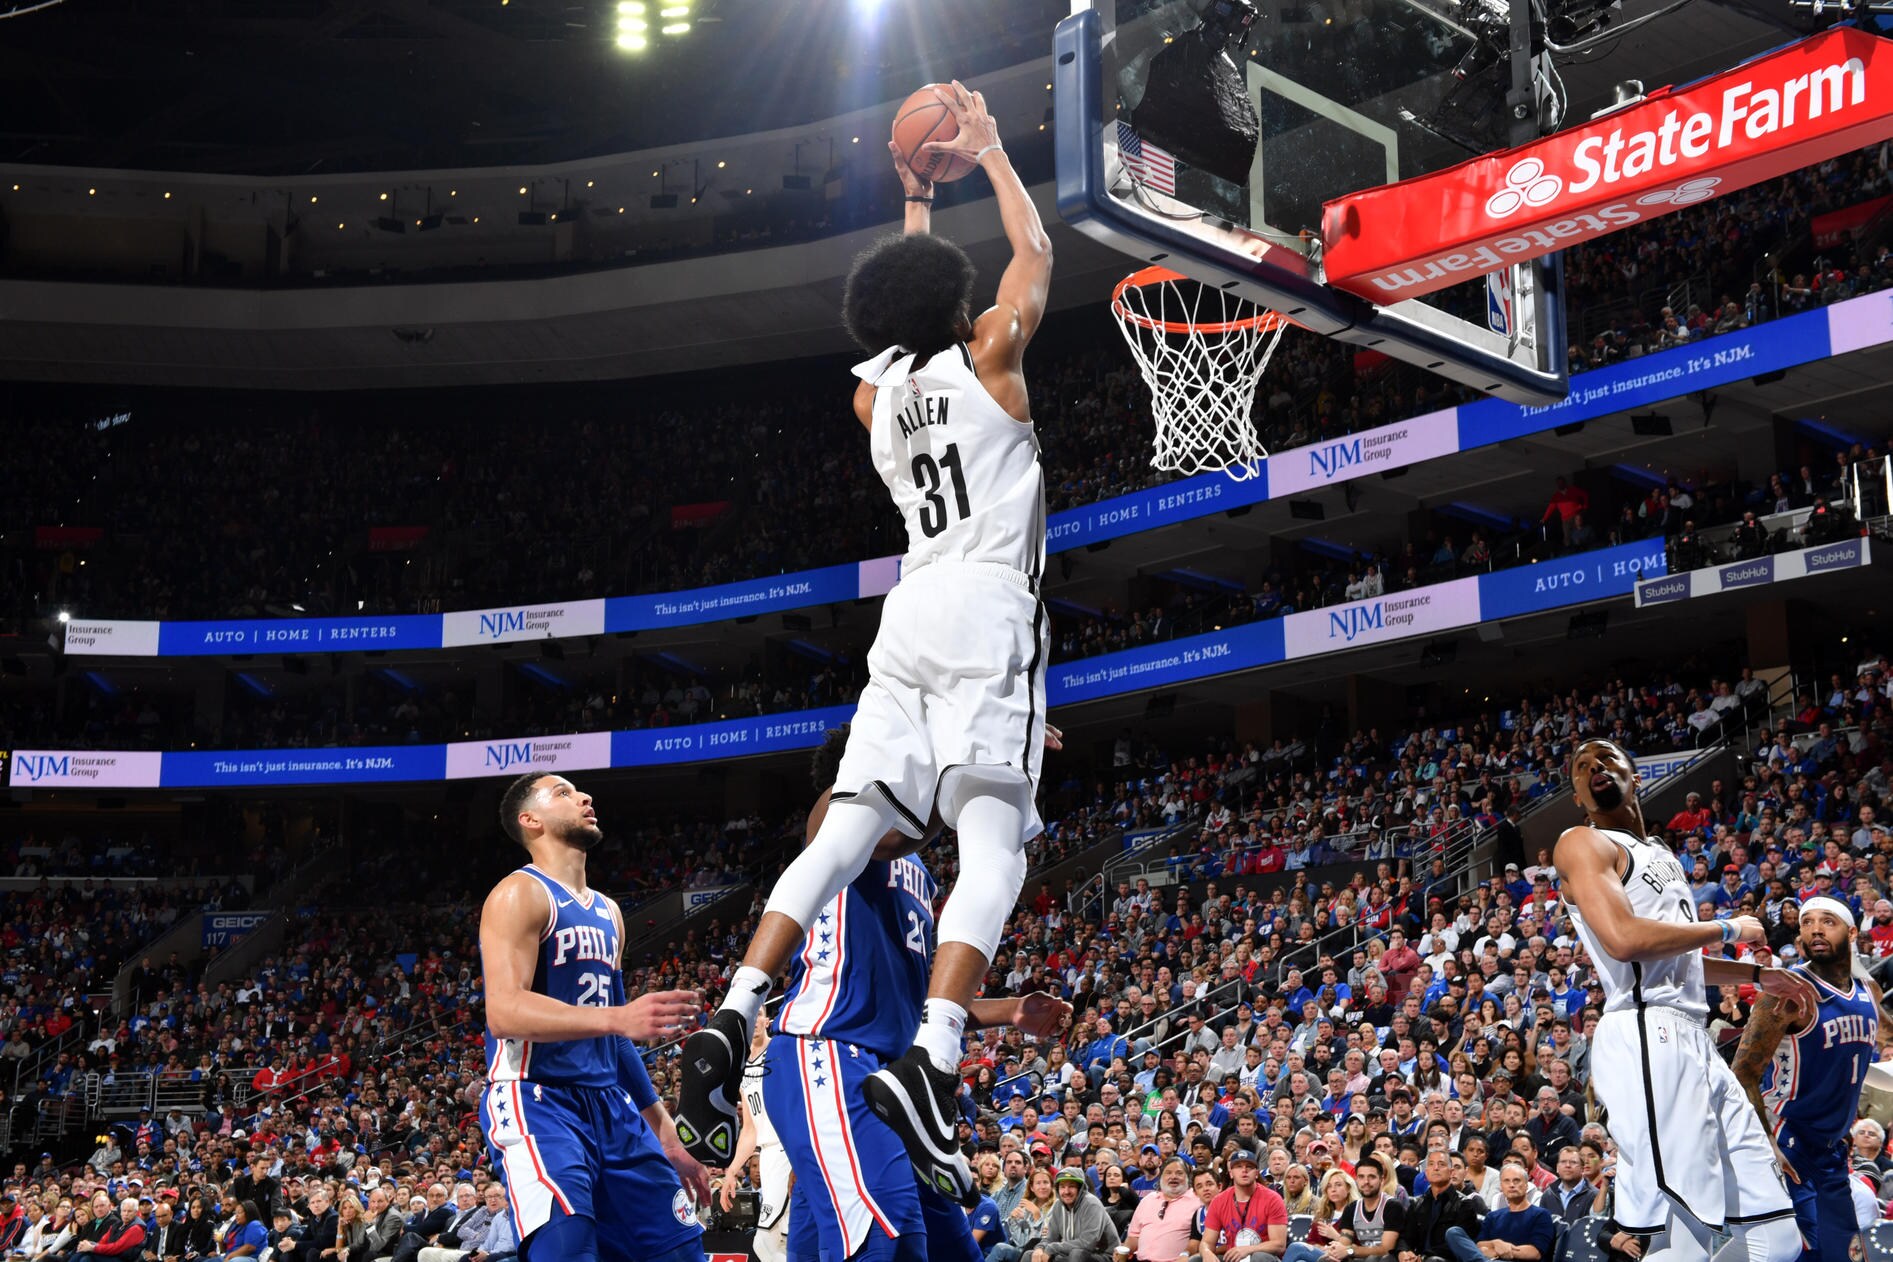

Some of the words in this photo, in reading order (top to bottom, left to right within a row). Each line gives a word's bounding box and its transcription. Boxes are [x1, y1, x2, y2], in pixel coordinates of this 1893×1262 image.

[1568, 57, 1866, 195] StateFarm
[1582, 383, 1610, 405] just
[1612, 368, 1685, 394] insurance.
[1687, 356, 1712, 374] It's
[1714, 343, 1755, 369] NJM.
[897, 396, 949, 440] ALLEN
[1363, 429, 1408, 449] Insurance
[1308, 438, 1363, 478] NJM
[1363, 446, 1393, 464] Group
[911, 442, 971, 538] 31
[1045, 519, 1081, 541] AUTO
[1099, 504, 1139, 527] HOME
[1158, 483, 1223, 512] RENTERS
[1811, 548, 1856, 567] StubHub
[1534, 569, 1585, 594] AUTO
[1726, 565, 1769, 583] StubHub
[655, 603, 677, 616] This
[679, 600, 700, 614] isn't
[700, 599, 718, 613] just
[720, 591, 767, 607] insurance.
[769, 587, 785, 599] It's
[786, 582, 812, 596] NJM.
[1645, 581, 1686, 599] StubHub
[1384, 593, 1431, 614] Insurance
[479, 610, 525, 638] NJM
[525, 618, 552, 632] Group
[526, 608, 565, 621] Insurance
[1329, 602, 1385, 641] NJM
[1384, 611, 1414, 628] Group
[68, 624, 113, 637] Insurance
[204, 631, 246, 644] AUTO
[265, 629, 310, 643] HOME
[330, 625, 397, 642] RENTERS
[67, 636, 96, 648] Group
[1063, 674, 1084, 689] This
[1086, 670, 1107, 685] isn't
[1107, 665, 1128, 682] just
[1129, 656, 1181, 676] insurance.
[1183, 649, 1201, 663] It's
[1202, 643, 1231, 660] NJM.
[654, 736, 692, 752] AUTO
[710, 729, 747, 746] HOME
[766, 719, 825, 740] RENTERS
[486, 743, 531, 769] NJM
[532, 741, 572, 753] Insurance
[14, 755, 69, 781] NJM
[70, 756, 117, 768] Insurance
[214, 760, 238, 774] This
[241, 760, 264, 774] isn't
[265, 760, 287, 775] just
[288, 760, 344, 773] insurance.
[345, 758, 363, 770] It's
[365, 757, 395, 770] NJM.
[531, 751, 558, 765] Group
[70, 766, 99, 779] Group
[206, 931, 226, 946] 117
[576, 972, 611, 1008] 25
[1850, 1053, 1860, 1086] 1
[747, 1091, 762, 1117] 00
